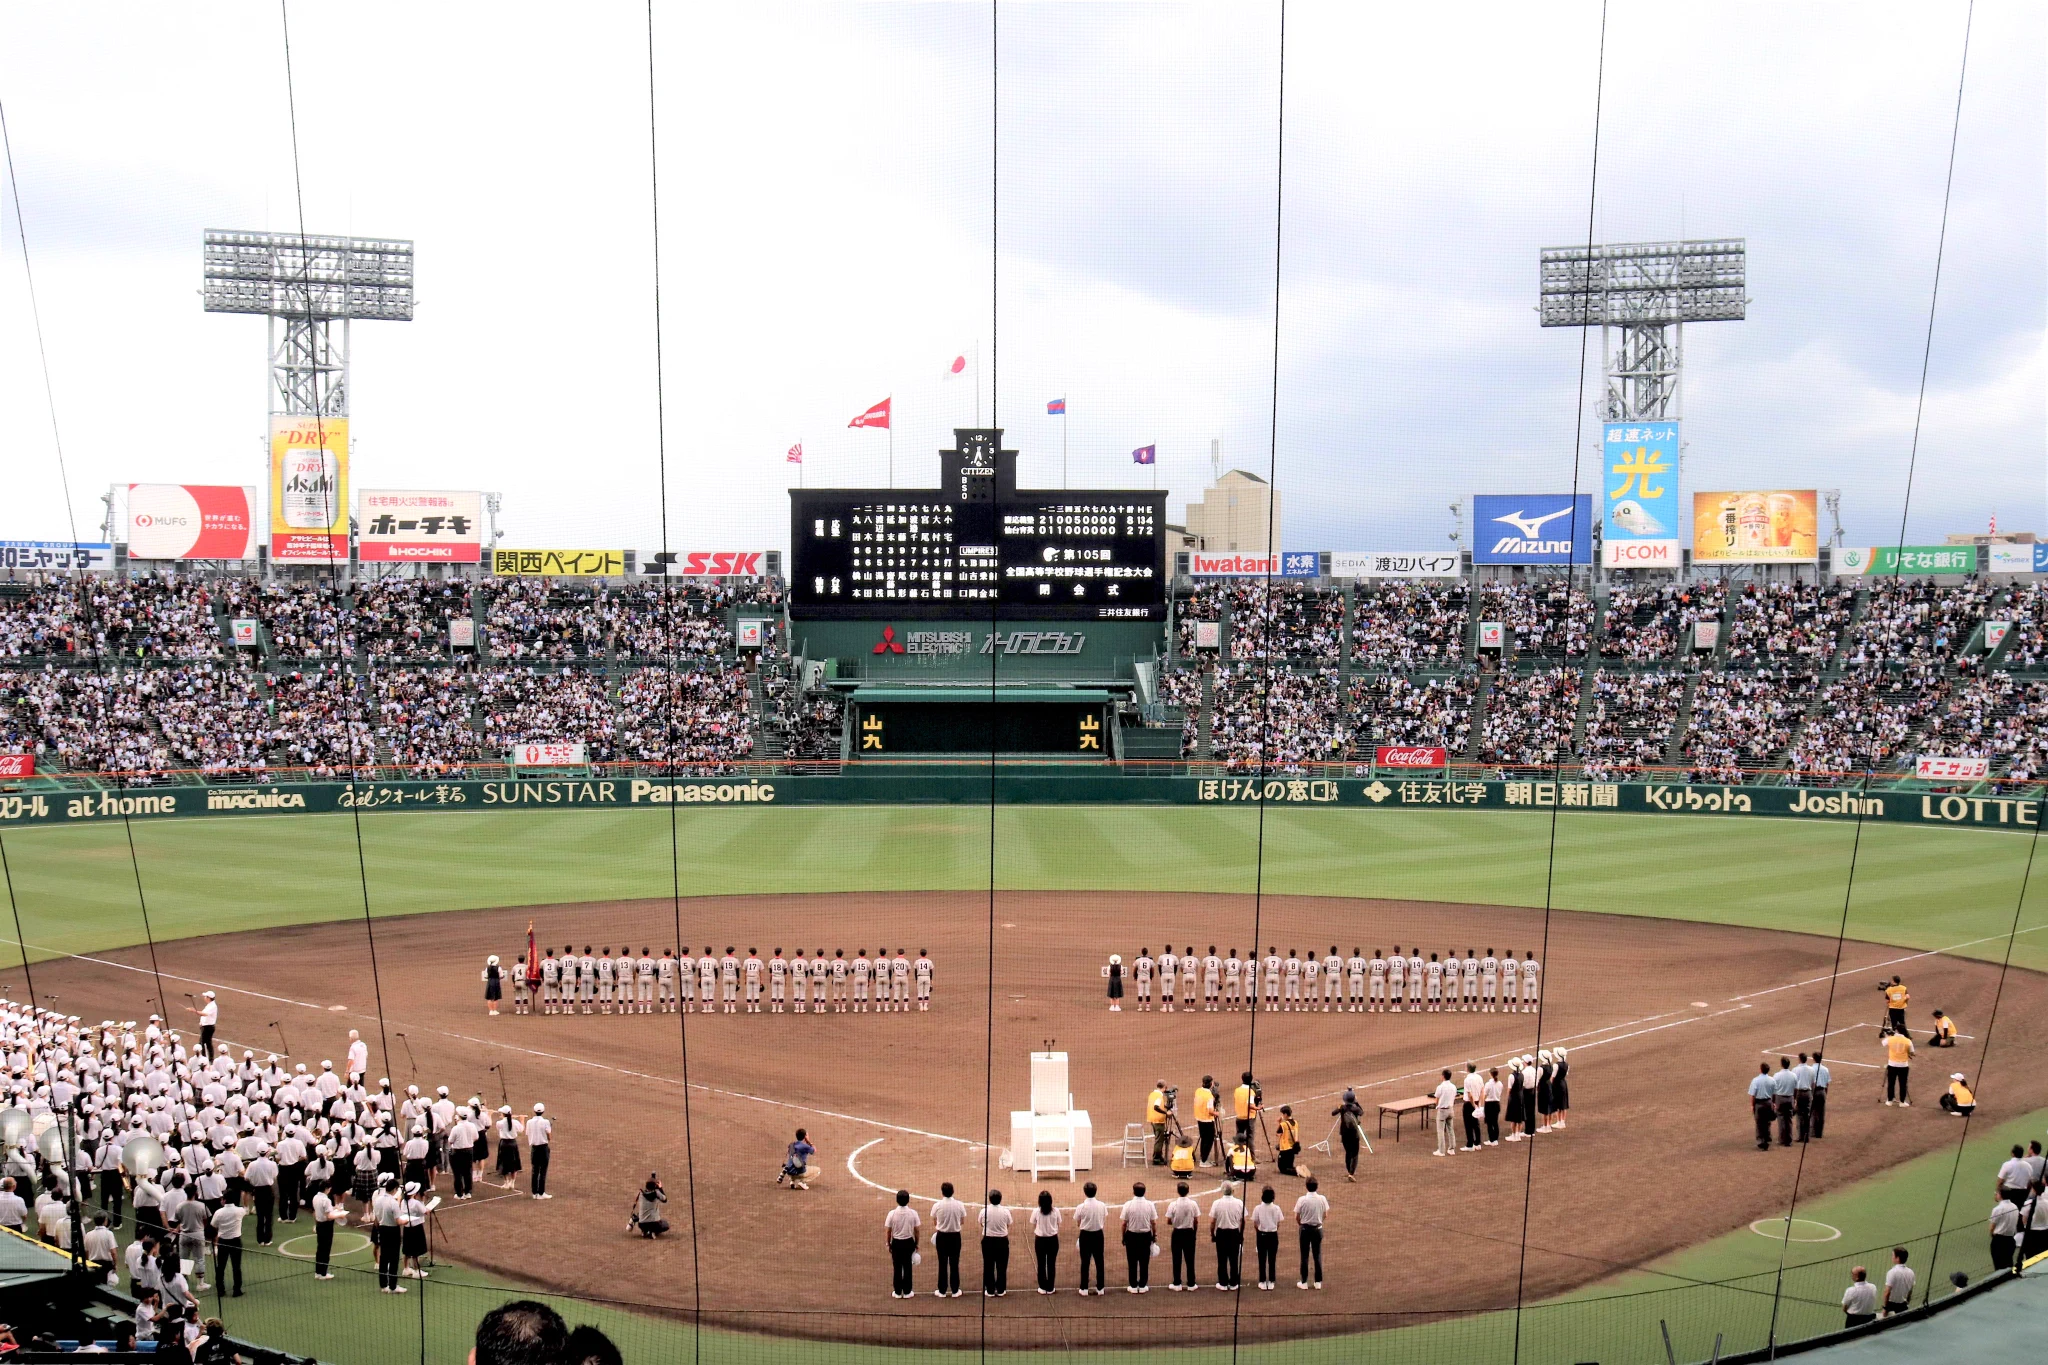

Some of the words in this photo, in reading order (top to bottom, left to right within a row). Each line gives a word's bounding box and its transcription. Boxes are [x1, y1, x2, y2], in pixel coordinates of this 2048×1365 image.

[1606, 428, 1676, 442] 超速ネット
[1610, 447, 1674, 500] 光
[287, 473, 333, 493] Asahi
[305, 497, 316, 505] 生
[368, 496, 454, 507] 住宅用火災警報器は
[155, 516, 187, 526] MUFG
[369, 515, 471, 534] ホーチキ
[1040, 516, 1046, 524] 2
[1049, 516, 1053, 524] 1
[1057, 516, 1063, 524] 0
[1065, 516, 1072, 524] 0
[1074, 516, 1080, 524] 5
[1083, 516, 1089, 524] 0
[1091, 516, 1097, 524] 0
[1100, 516, 1106, 524] 0
[1109, 516, 1115, 524] 0
[1127, 516, 1133, 524] 8
[1137, 516, 1146, 524] 13
[1146, 516, 1153, 524] 4
[1726, 508, 1736, 546] 一番搾り
[1040, 526, 1046, 534] 0
[1049, 526, 1053, 534] 1
[1057, 526, 1061, 534] 1
[1065, 526, 1072, 534] 0
[1074, 526, 1080, 534] 0
[1083, 526, 1089, 534] 0
[1091, 526, 1097, 534] 0
[1100, 526, 1106, 534] 0
[1109, 526, 1115, 534] 0
[1127, 526, 1133, 534] 2
[1138, 526, 1143, 534] 7
[1146, 526, 1153, 534] 2
[398, 548, 451, 556] HOCHIKI
[1064, 549, 1111, 560] 第105回
[1613, 545, 1667, 562] J:COM
[1886, 551, 1967, 568] りそな銀行
[496, 552, 622, 573] 関西ペイント
[683, 553, 763, 574] SSK
[1194, 555, 1277, 572] Iwatani
[1286, 555, 1314, 568] 水素
[1375, 556, 1458, 572] 渡辺パイプ
[1099, 608, 1149, 617] 三井住友銀行
[907, 632, 971, 643] MITSUBISHI
[907, 643, 963, 654] ELECTRIC
[863, 714, 883, 750] 山九
[1080, 714, 1099, 750] 山九
[1385, 749, 1436, 764] Coca-Cola
[1919, 762, 1987, 777] 不二サッシ
[380, 784, 466, 804] クオール薬局
[483, 782, 616, 803] SUNSTAR
[631, 779, 775, 803] Panasonic
[1397, 782, 1486, 804] 住友化学
[1504, 783, 1618, 807] 朝日新聞
[1646, 786, 1752, 812] Kubota
[1790, 790, 1883, 816] Joshin
[1922, 796, 2037, 825] LOTTE
